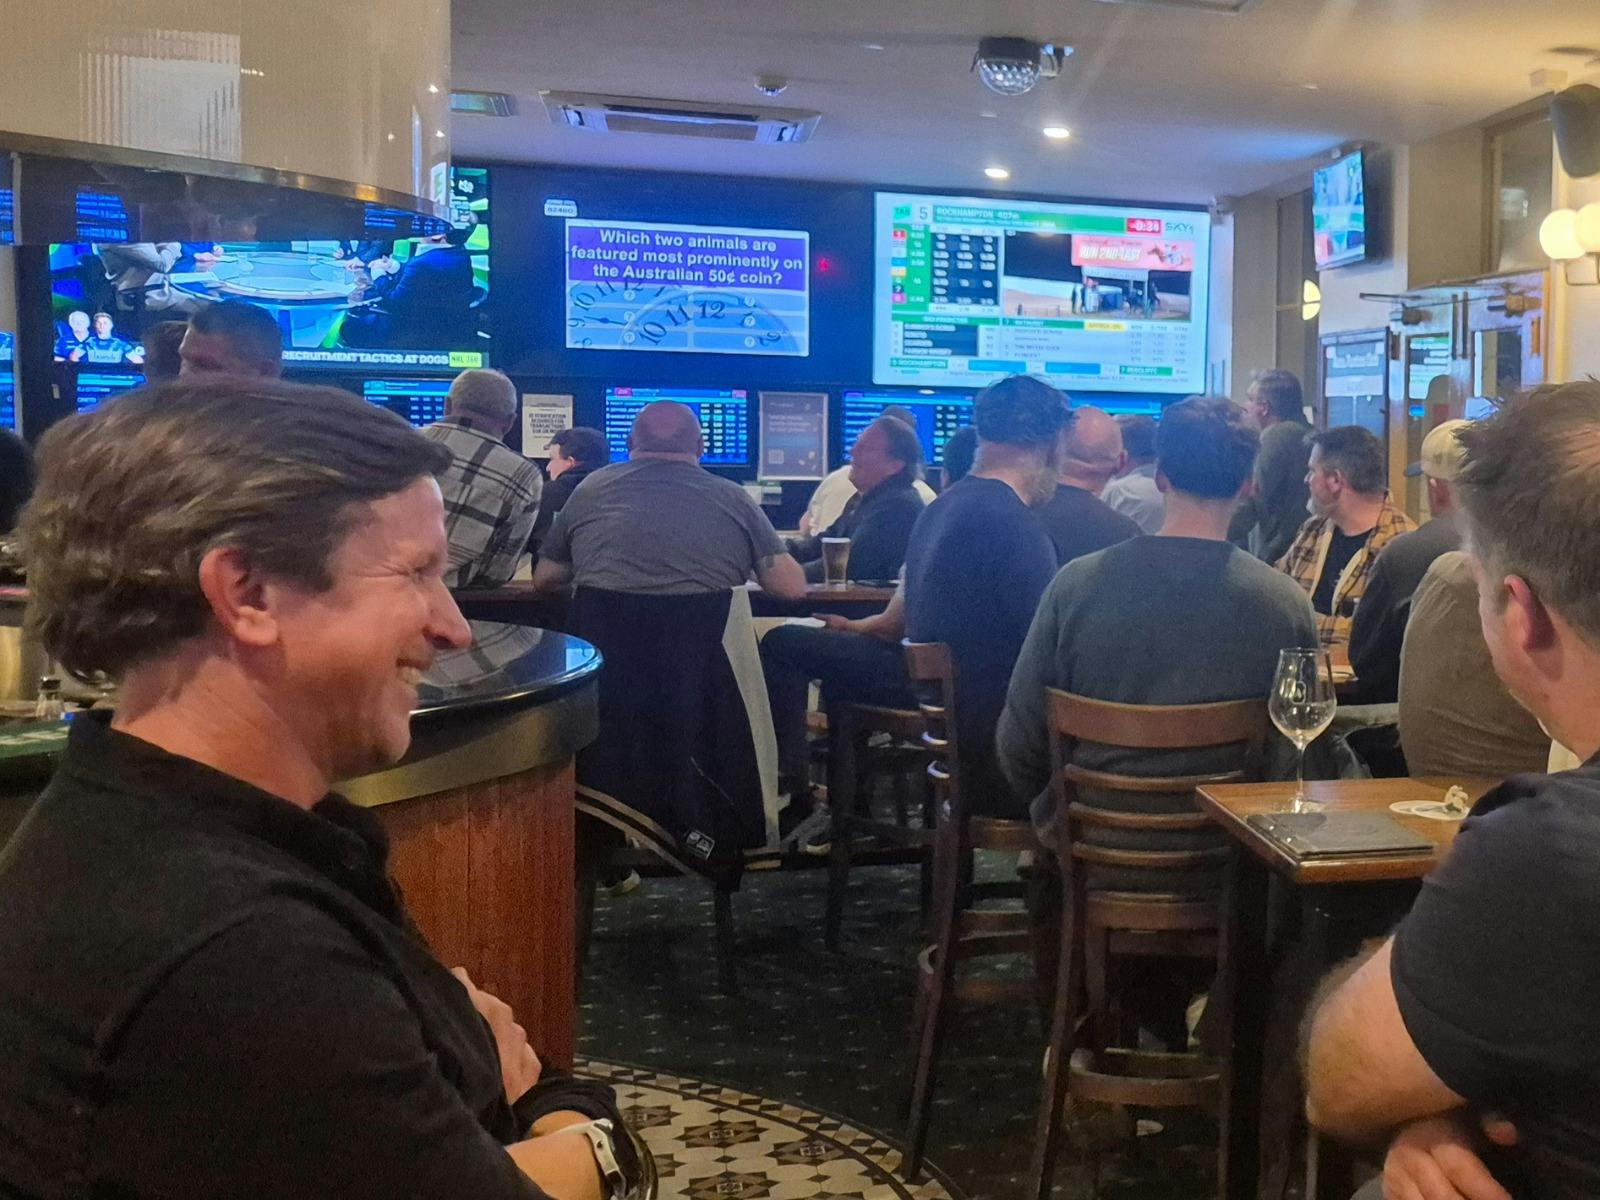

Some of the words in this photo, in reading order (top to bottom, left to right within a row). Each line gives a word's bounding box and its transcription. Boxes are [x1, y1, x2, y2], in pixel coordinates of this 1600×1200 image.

[919, 207, 928, 220] 5
[936, 206, 994, 219] ROCKHAMPTON
[600, 229, 650, 245] Which
[655, 233, 683, 247] two
[688, 235, 748, 250] animals
[752, 240, 777, 252] are
[571, 245, 638, 261] featured
[643, 251, 683, 264] most
[687, 253, 779, 271] prominently
[783, 259, 802, 270] on
[593, 264, 619, 277] the
[622, 265, 704, 281] Australian
[709, 269, 736, 285] 50¢
[739, 271, 782, 285] coin?
[665, 304, 691, 327] 11
[698, 300, 726, 320] 12
[639, 321, 668, 345] 10
[281, 350, 358, 363] RECRUITMENT
[359, 353, 403, 364] TACTICS
[404, 353, 419, 364] AT
[419, 354, 449, 365] DOGS
